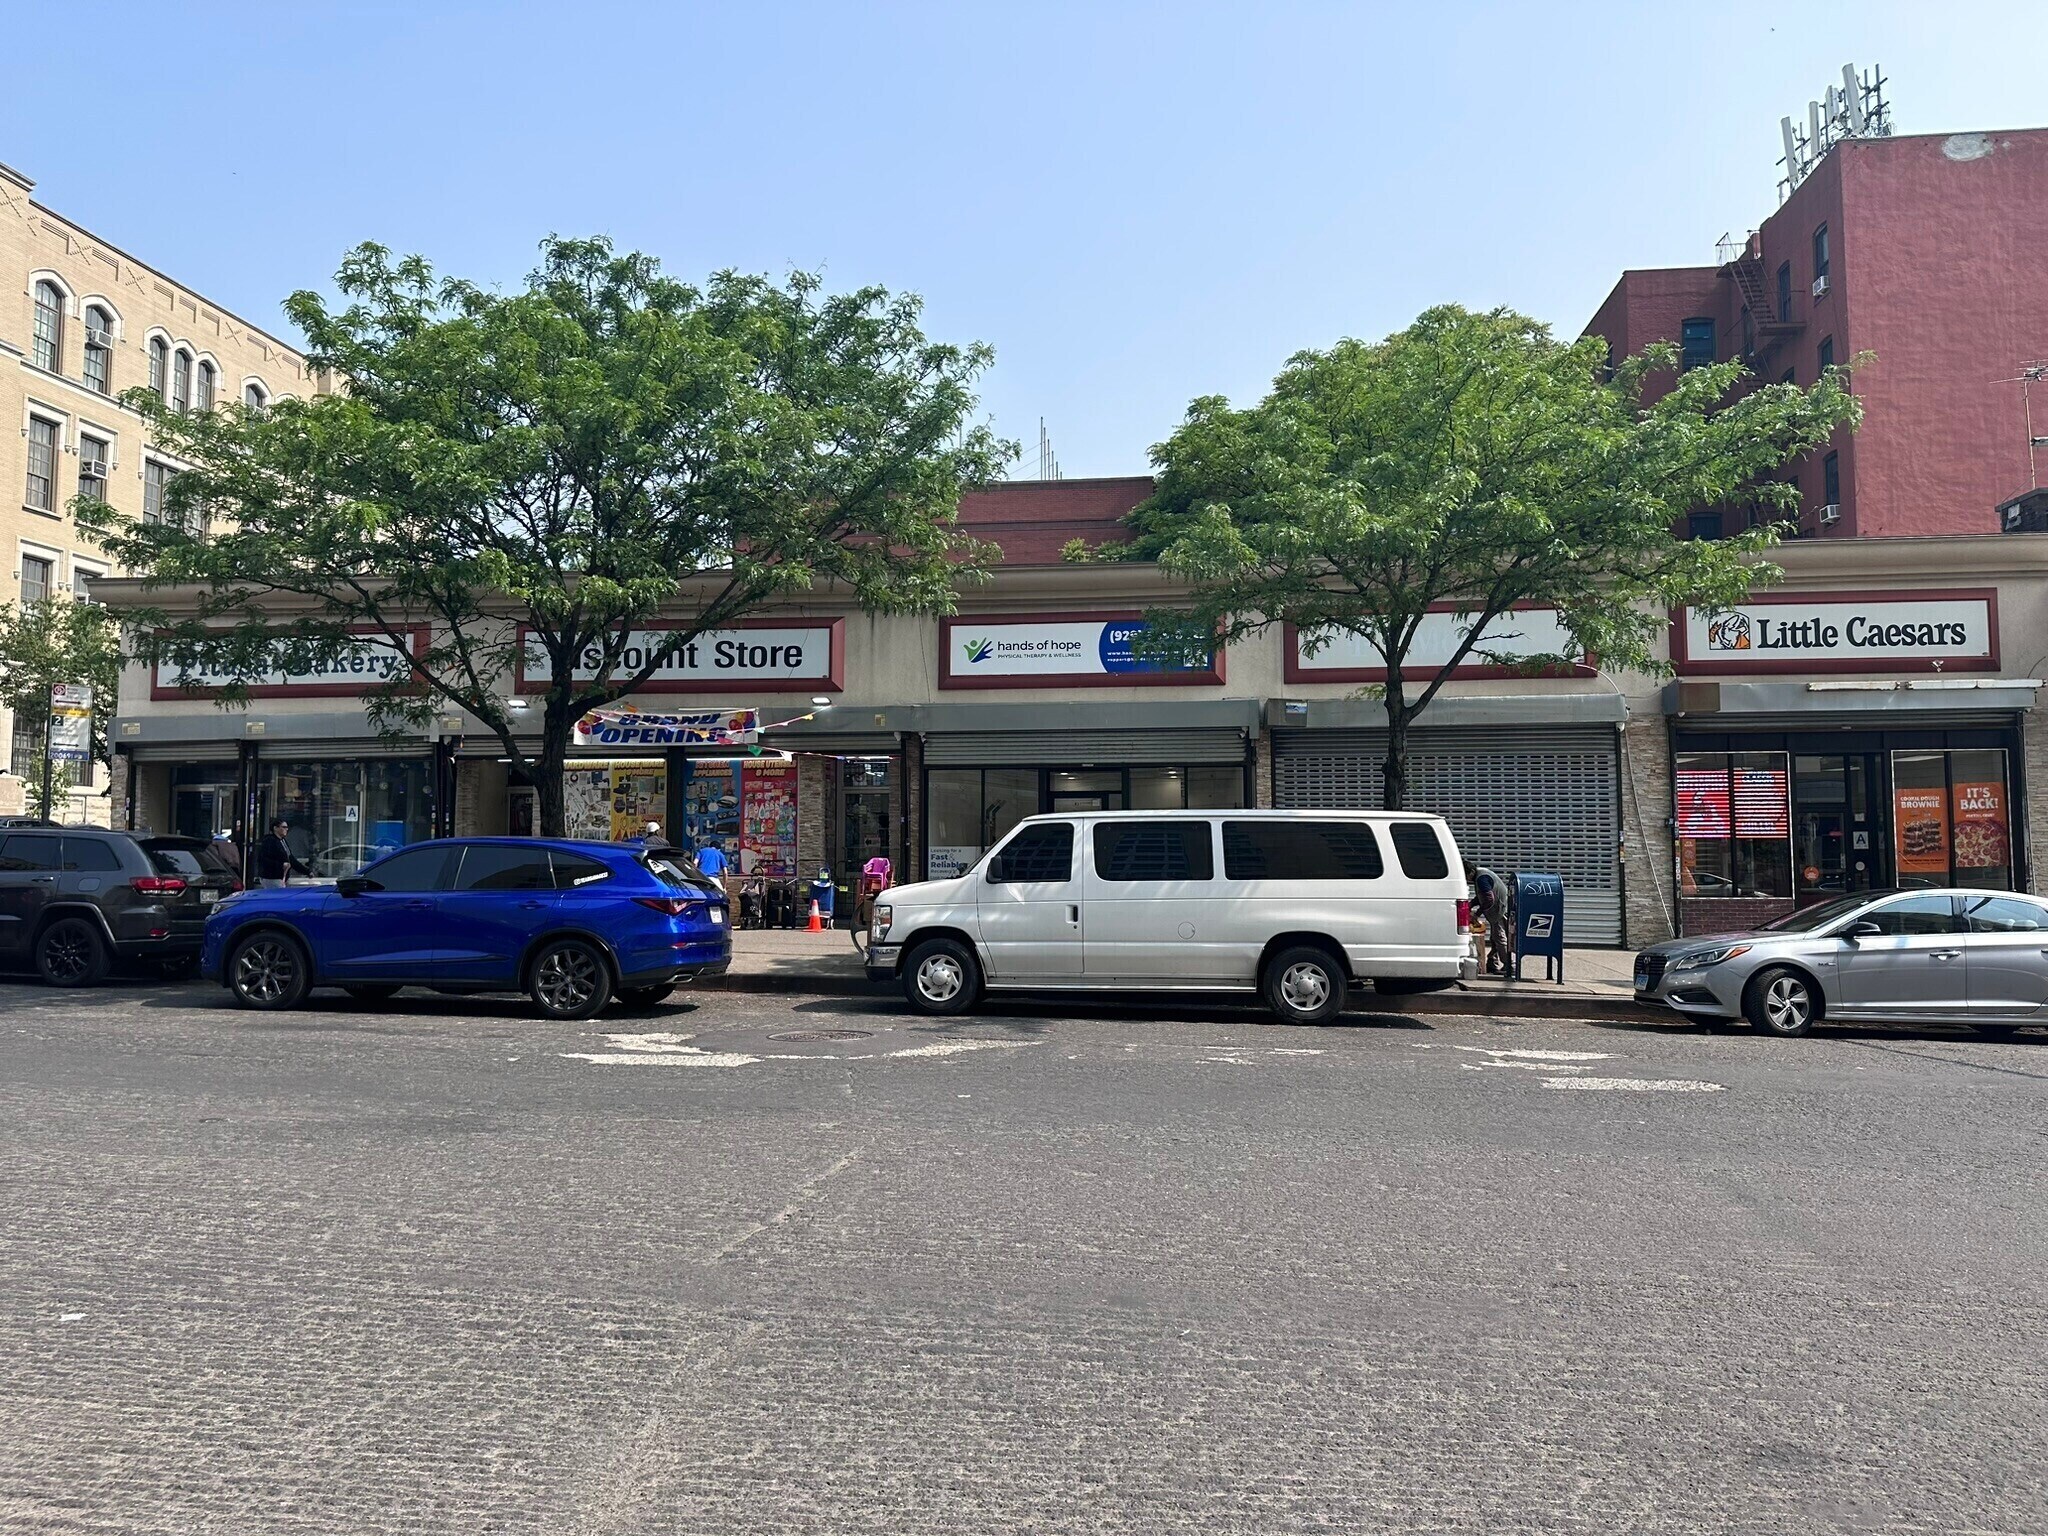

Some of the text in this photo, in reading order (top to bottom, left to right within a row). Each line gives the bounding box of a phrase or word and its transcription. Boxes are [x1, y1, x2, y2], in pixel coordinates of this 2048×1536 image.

[1756, 617, 1967, 649] Little Caesars
[997, 640, 1081, 651] hands of hope
[714, 641, 803, 668] Store
[55, 716, 60, 725] 2
[1966, 788, 1991, 798] IT'S
[1960, 798, 1999, 810] BACK!
[348, 807, 356, 817] A
[1856, 834, 1866, 844] A
